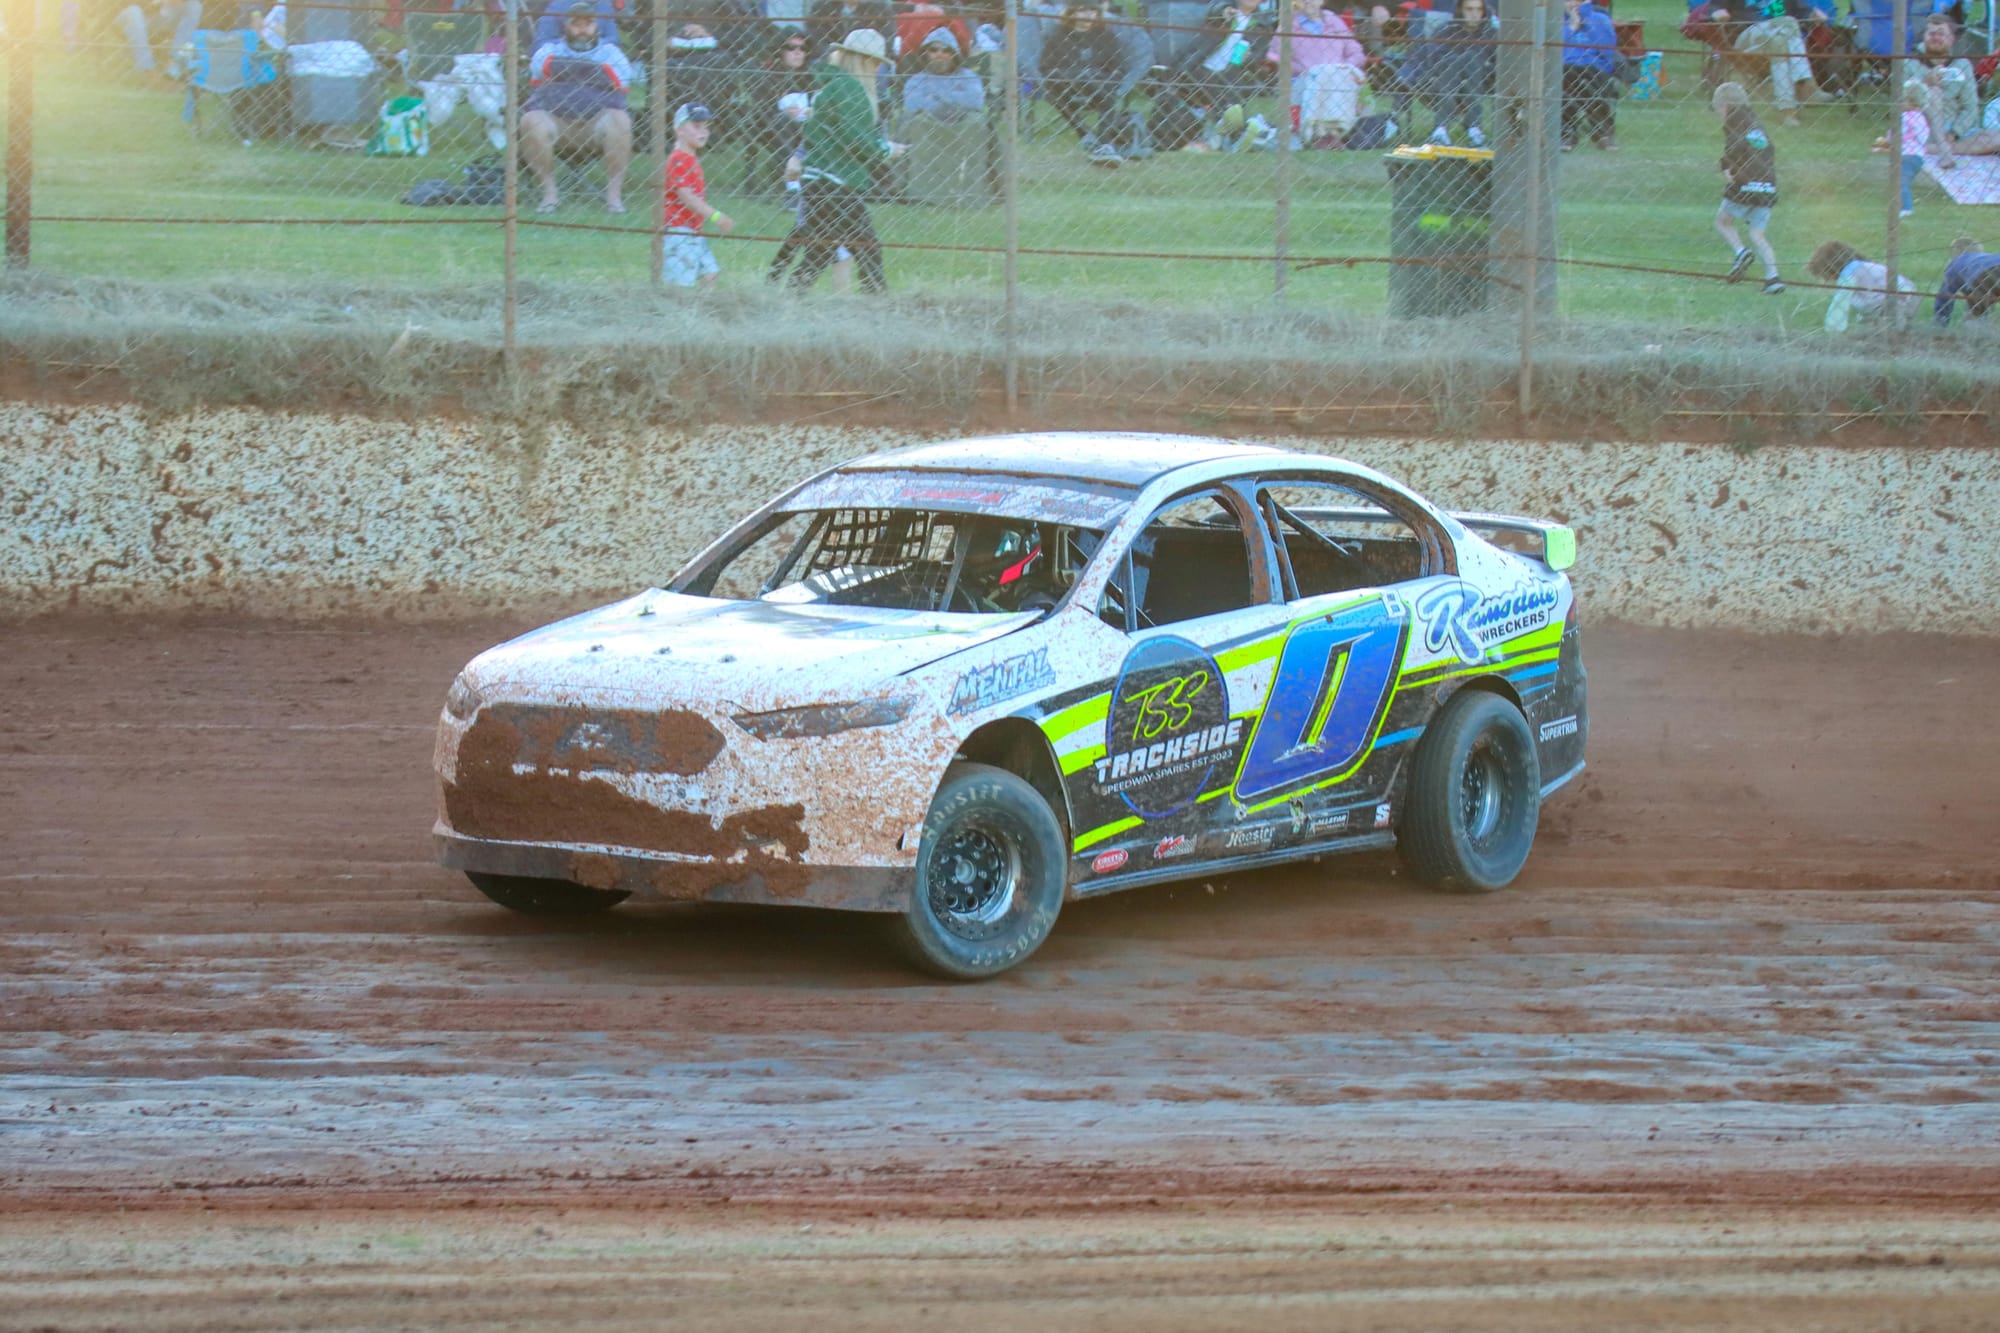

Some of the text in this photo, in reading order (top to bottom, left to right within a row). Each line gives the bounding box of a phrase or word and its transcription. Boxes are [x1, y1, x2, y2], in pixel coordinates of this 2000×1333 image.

[1481, 611, 1546, 641] WRECKERS
[1124, 670, 1208, 740] TSS
[1094, 719, 1243, 784] TRACKSIDE
[1102, 748, 1233, 796] SPEEDWAY SPARES EST 2023
[1225, 825, 1276, 849] Hoosier
